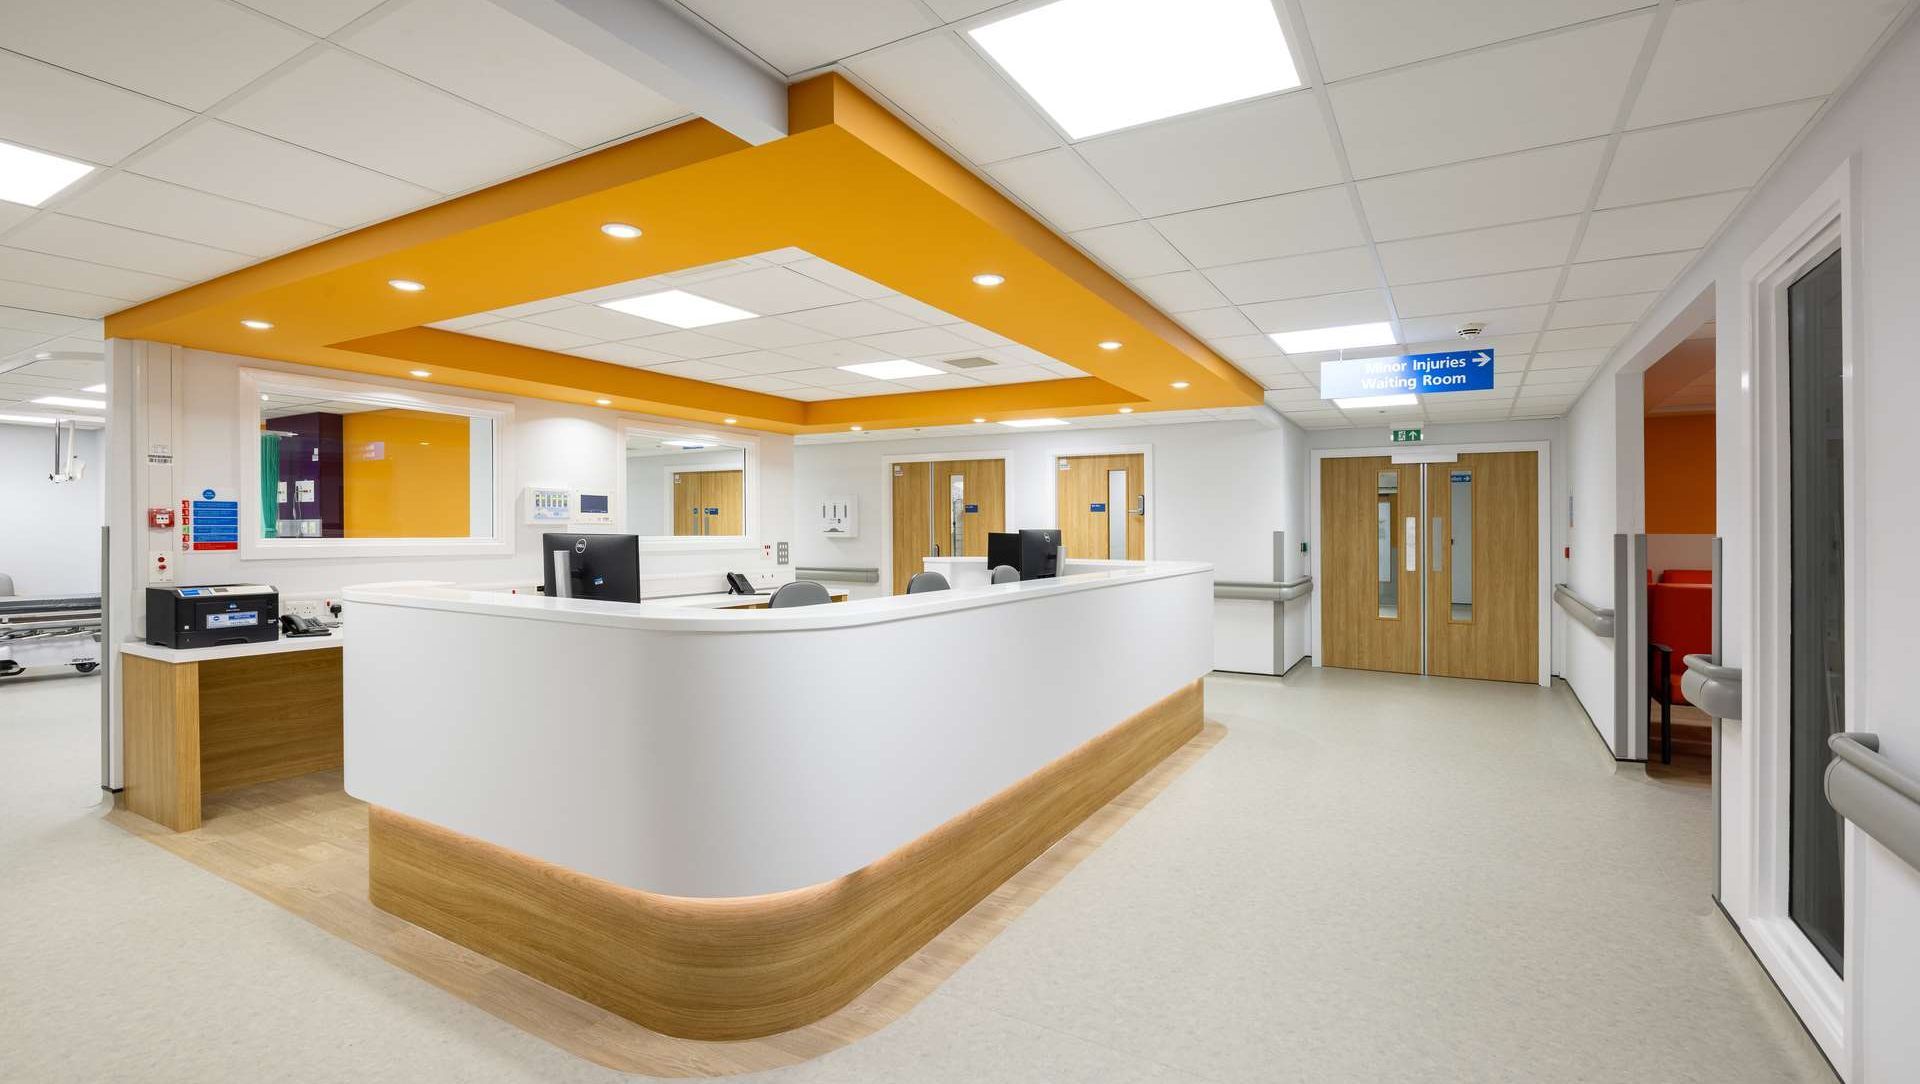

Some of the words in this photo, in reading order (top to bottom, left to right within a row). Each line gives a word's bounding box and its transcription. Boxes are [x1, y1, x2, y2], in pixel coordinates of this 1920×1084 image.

[1365, 362, 1407, 374] Minor
[1413, 357, 1466, 373] Injuries
[1361, 376, 1417, 389] Waiting
[1423, 374, 1466, 386] Room
